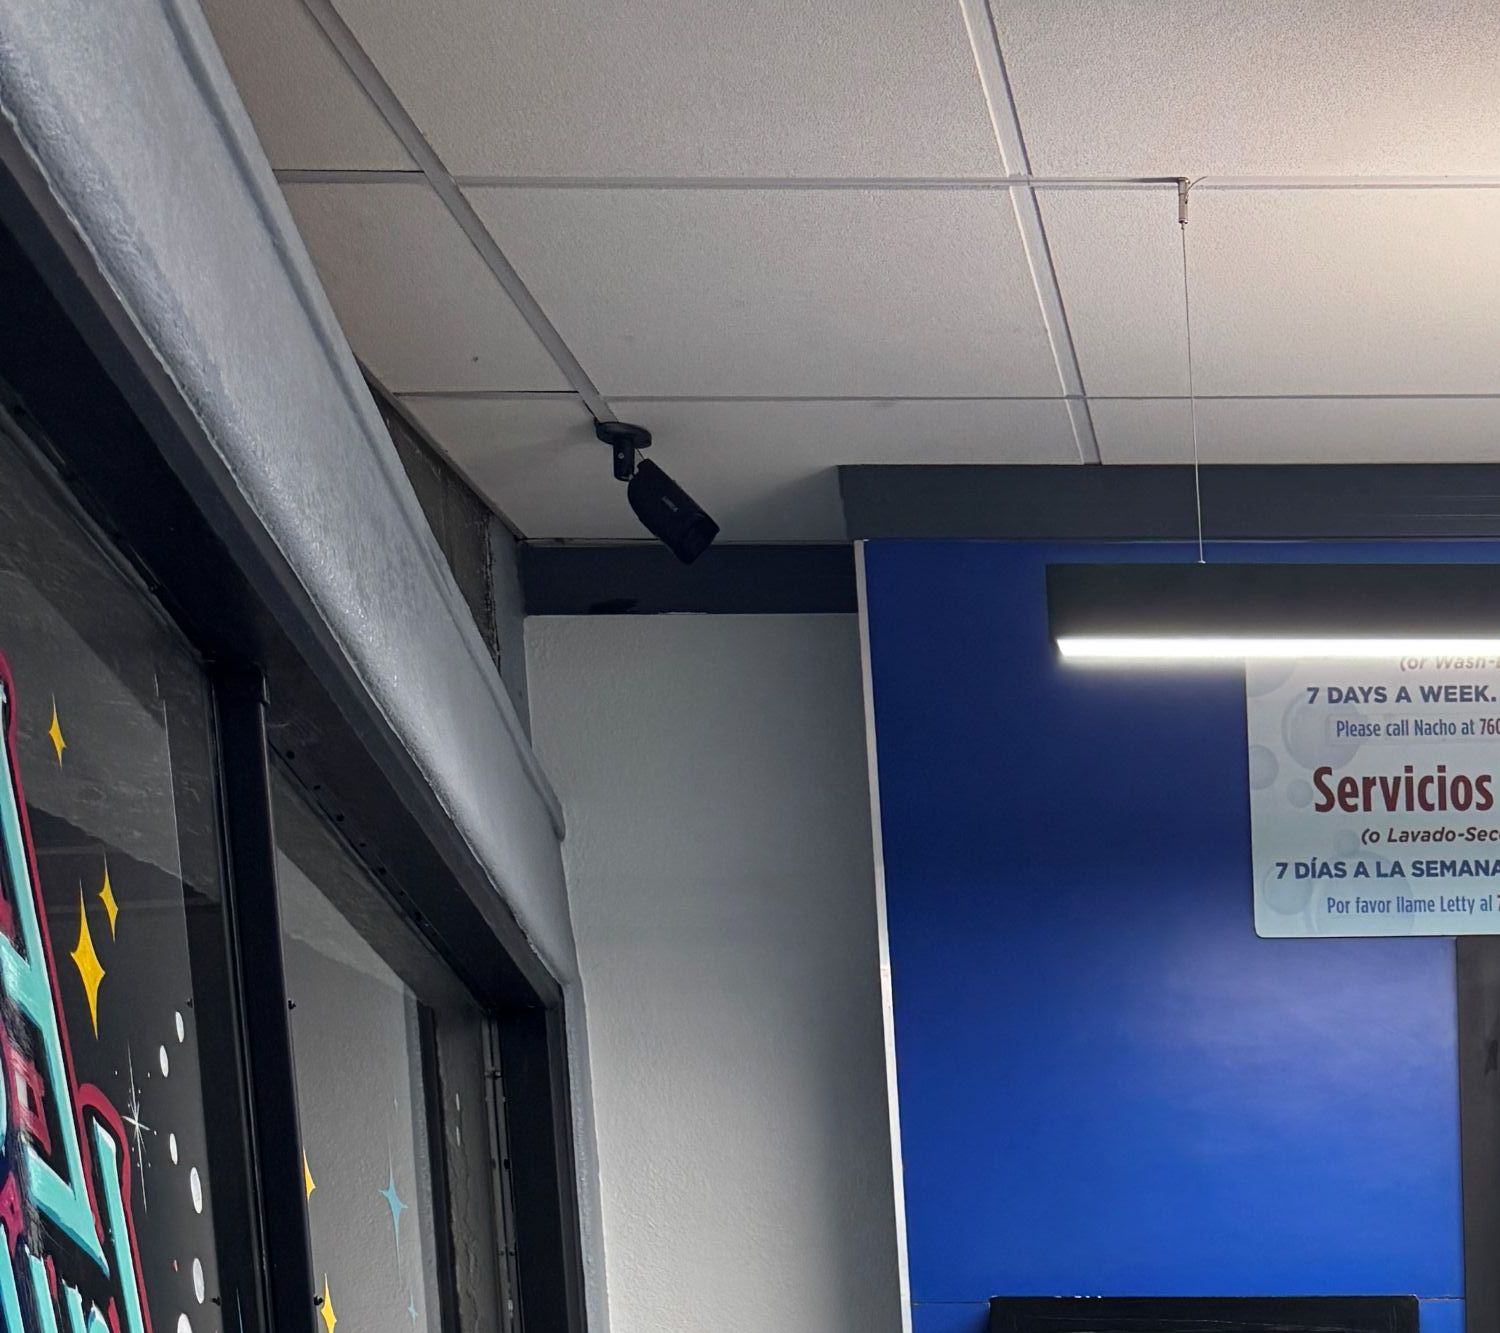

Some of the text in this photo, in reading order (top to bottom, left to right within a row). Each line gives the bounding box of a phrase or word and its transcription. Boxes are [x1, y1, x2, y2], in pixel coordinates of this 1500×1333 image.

[1307, 687, 1319, 704] 7
[1328, 686, 1387, 704] DAYS
[1395, 686, 1412, 703] A
[1419, 685, 1496, 703] WEEK.
[1337, 720, 1380, 737] Please
[1386, 720, 1409, 736] call
[1415, 719, 1456, 736] Nacho
[1461, 719, 1475, 735] at
[1313, 765, 1493, 813] Servicios
[1362, 829, 1380, 845] (o
[1276, 862, 1288, 879] 7
[1295, 857, 1347, 879] DÍAS
[1354, 861, 1370, 878] A
[1376, 861, 1405, 878] LA
[1327, 897, 1350, 913] Por
[1356, 897, 1392, 913] favor
[1396, 896, 1435, 912] llame
[1440, 896, 1475, 914] Letty
[1480, 895, 1492, 911] al
